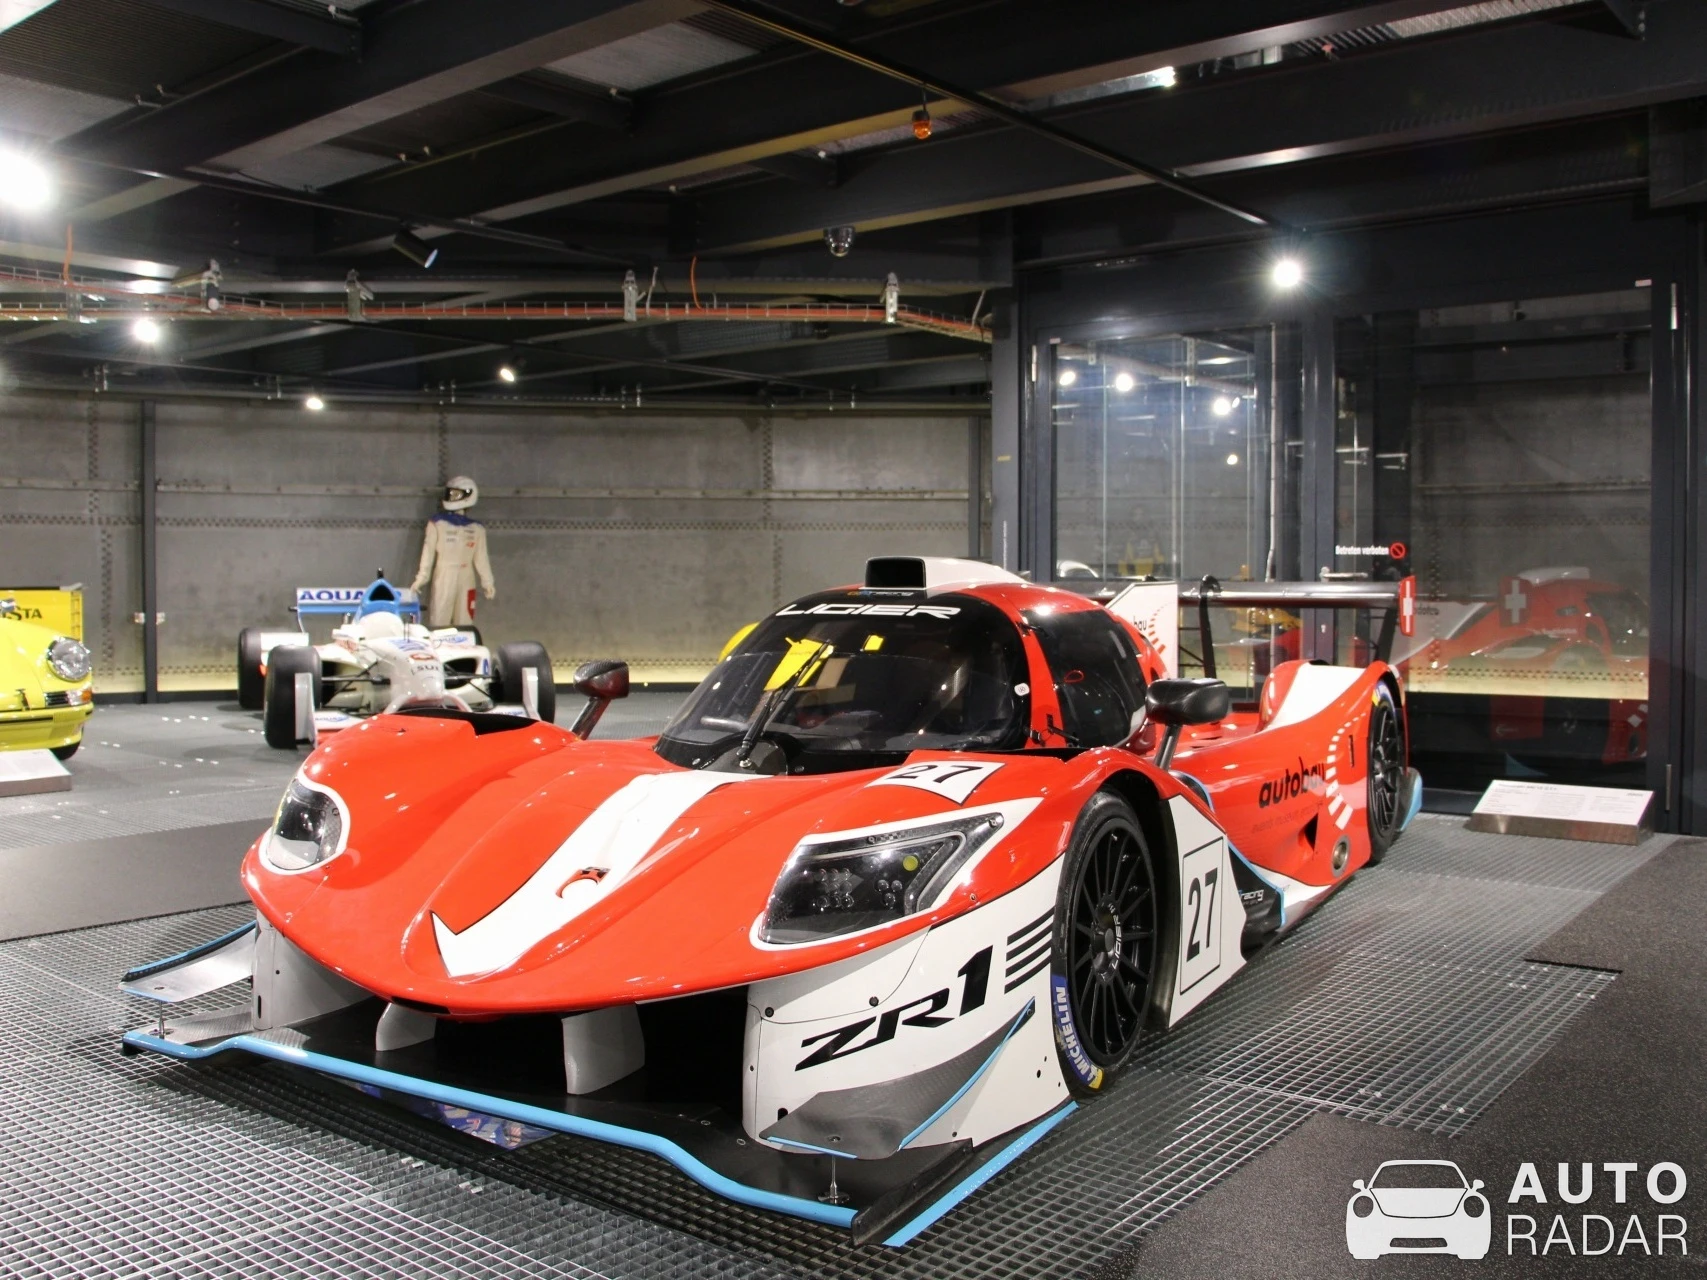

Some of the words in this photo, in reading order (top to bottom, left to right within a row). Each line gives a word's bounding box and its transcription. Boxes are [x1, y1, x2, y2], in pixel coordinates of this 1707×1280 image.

[1335, 545, 1361, 555] Betreten
[1362, 545, 1389, 555] verboten
[301, 590, 364, 601] AQUA
[775, 603, 961, 619] LIGIER
[884, 764, 984, 784] 27
[1259, 756, 1325, 809] autobau
[1186, 867, 1218, 963] 27
[1111, 914, 1122, 970] LIGIER
[795, 944, 994, 1072] ZR1
[1055, 986, 1090, 1076] MICHELIN
